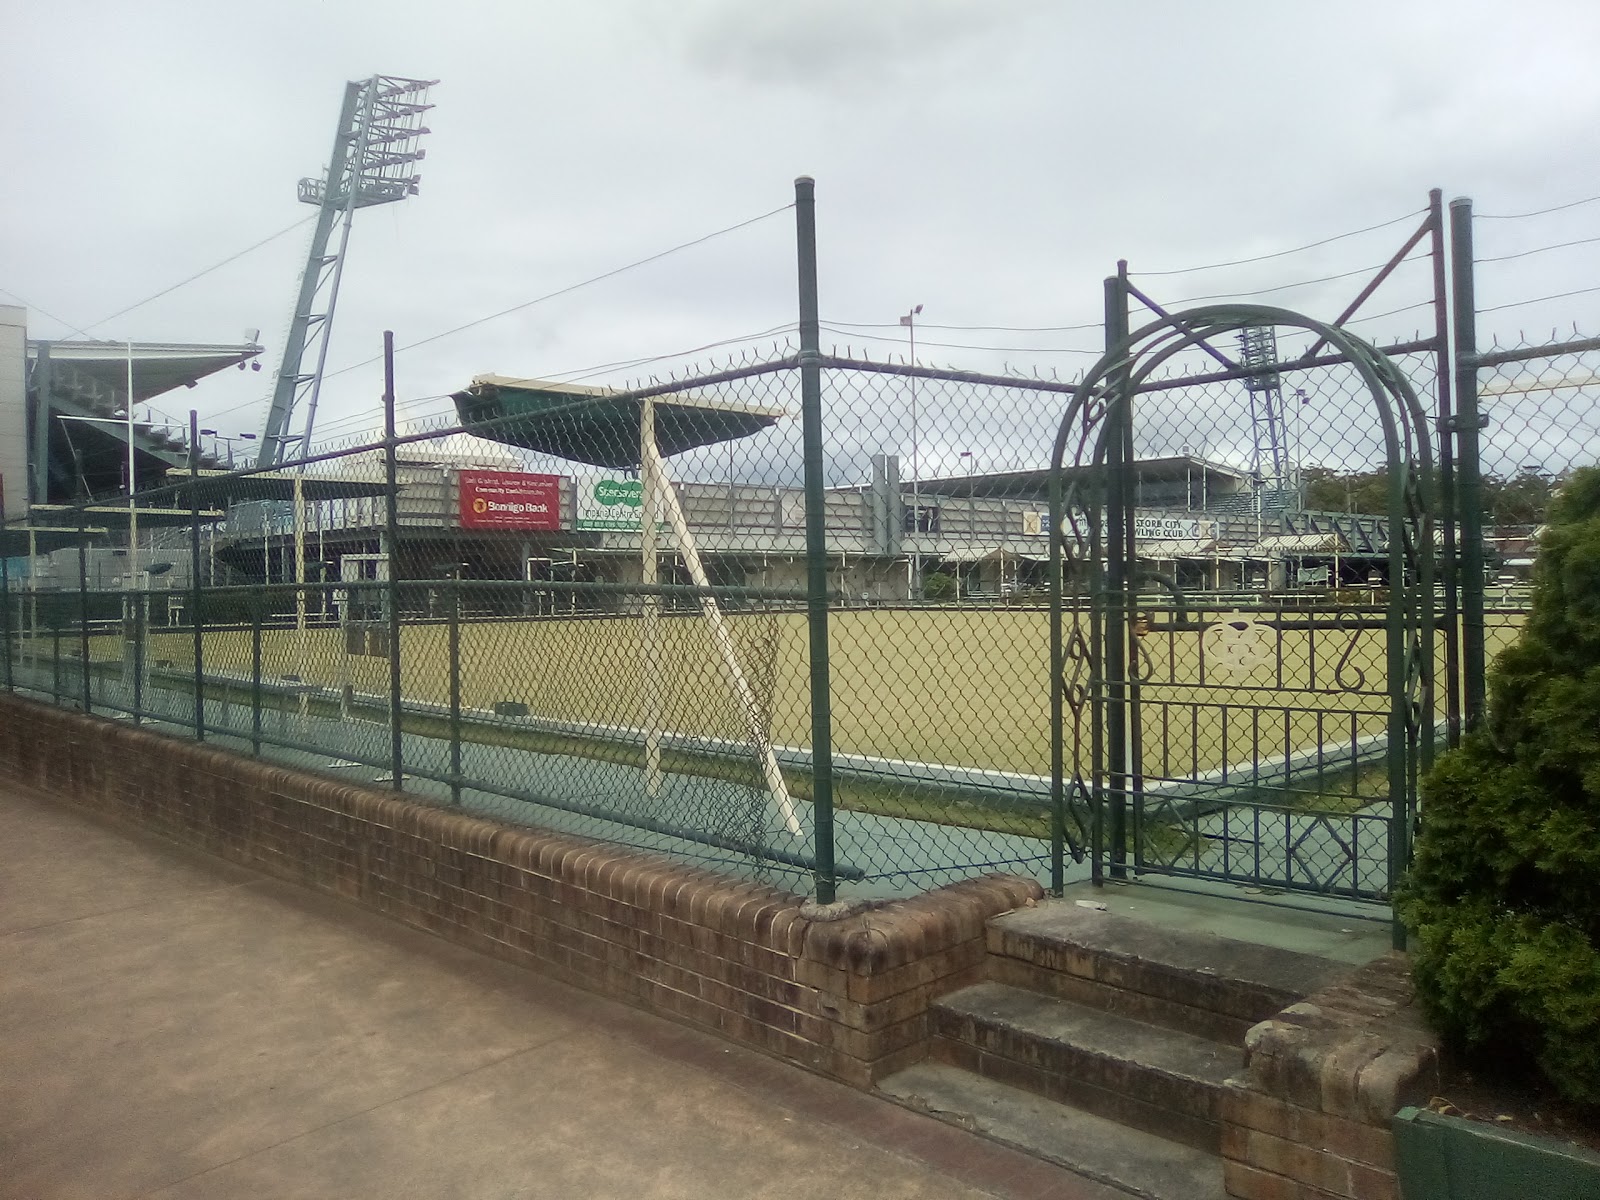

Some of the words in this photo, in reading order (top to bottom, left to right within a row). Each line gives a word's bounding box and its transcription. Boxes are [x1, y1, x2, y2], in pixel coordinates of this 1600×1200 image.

[525, 503, 549, 513] Bank
[1135, 519, 1162, 528] SFORD
[1164, 520, 1182, 529] CITY
[1135, 528, 1161, 537] WLING
[1163, 529, 1183, 538] CLUB
